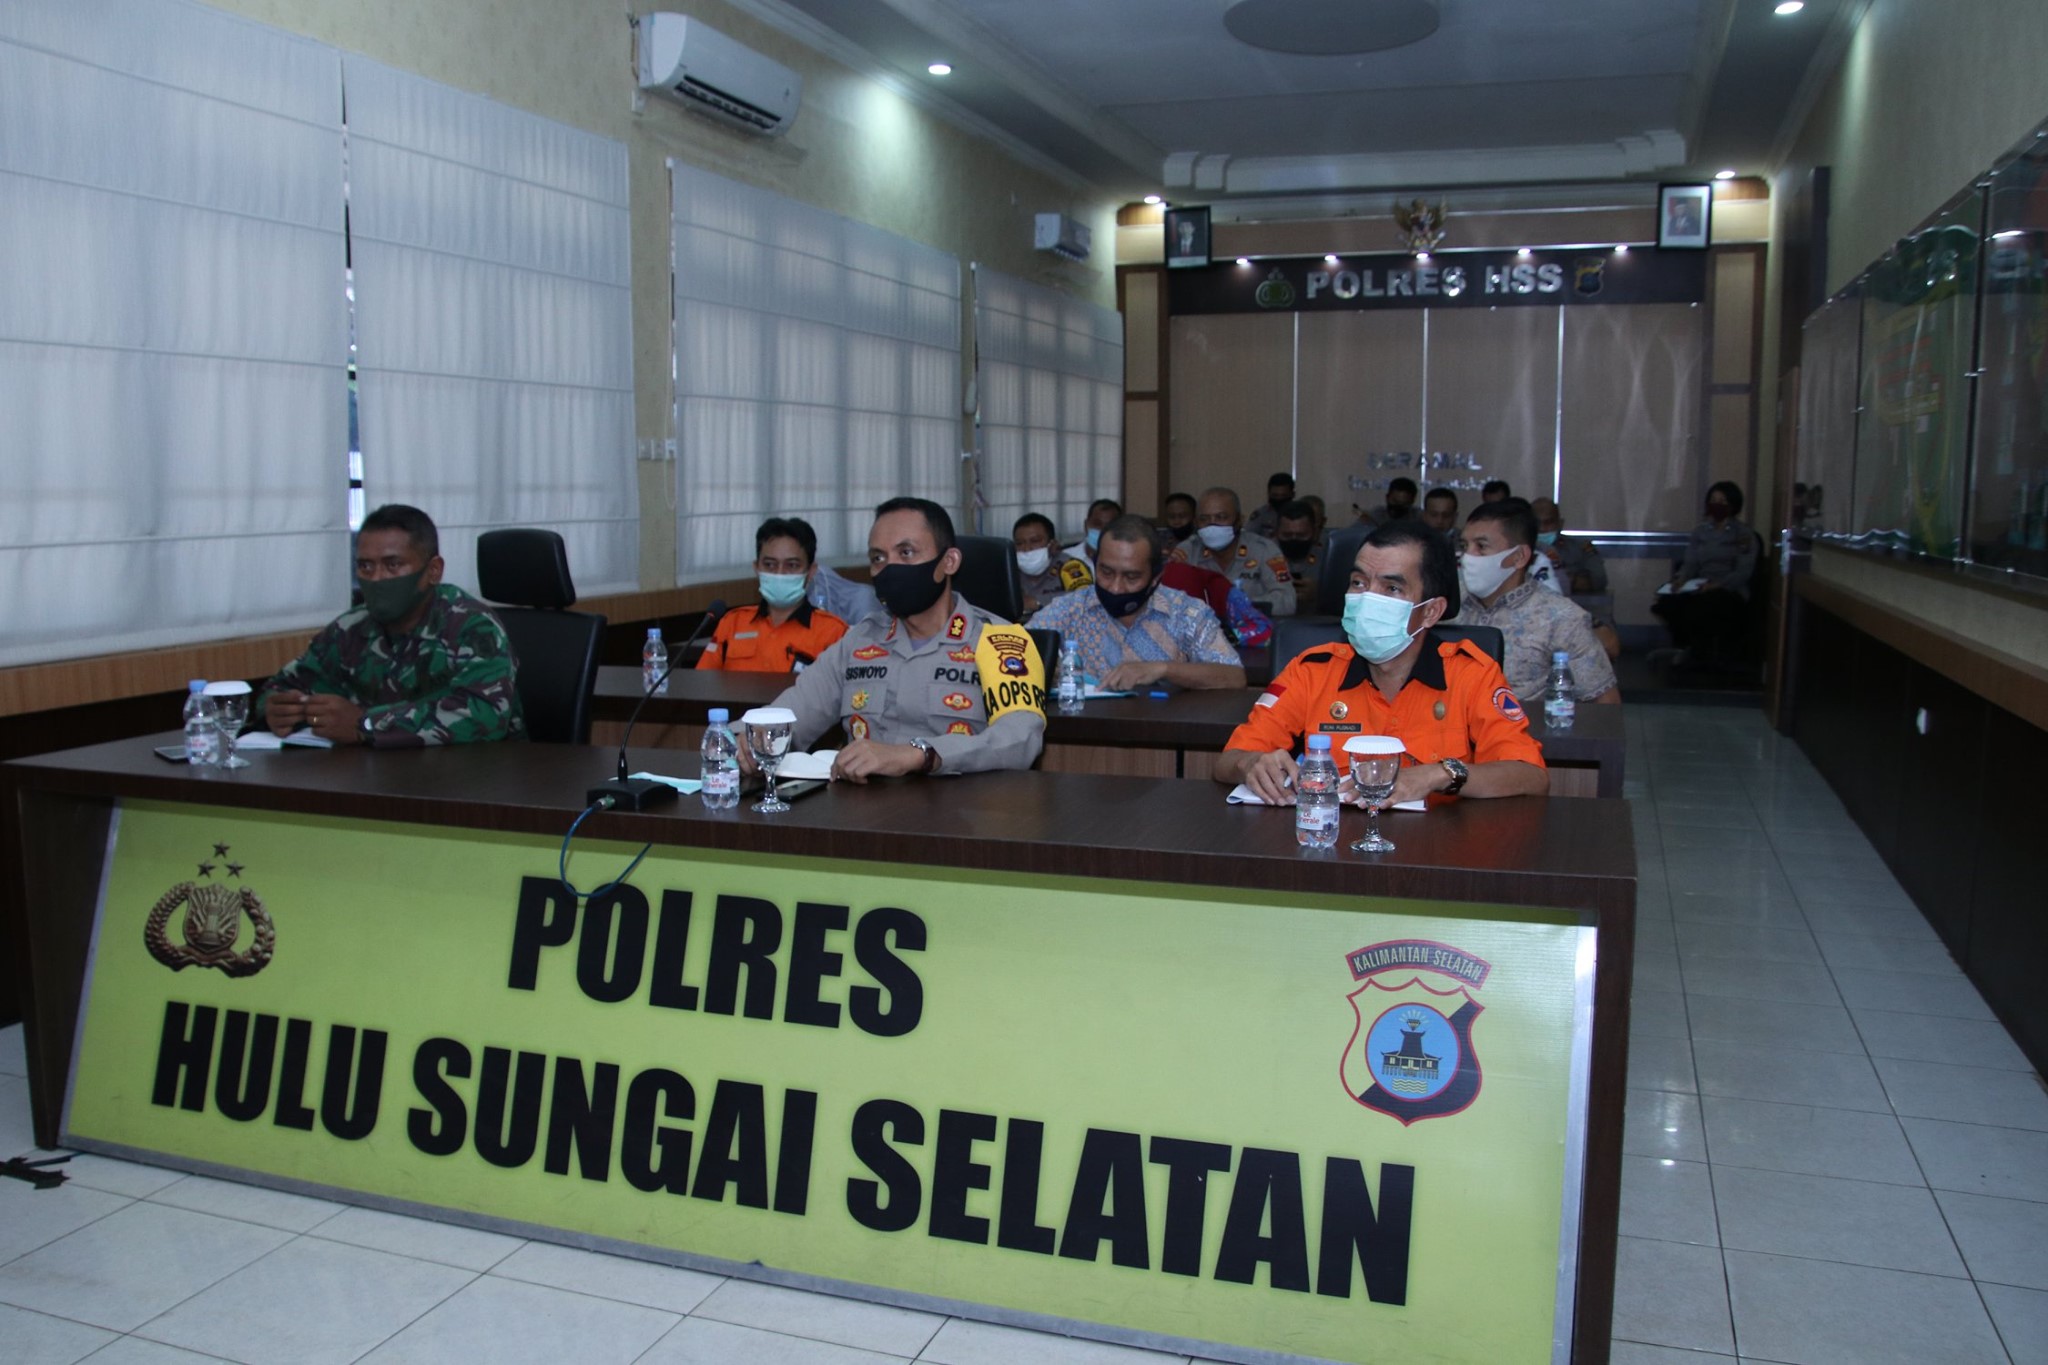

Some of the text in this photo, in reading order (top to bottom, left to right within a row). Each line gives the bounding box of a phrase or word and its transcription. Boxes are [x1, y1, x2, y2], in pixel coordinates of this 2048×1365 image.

[1306, 263, 1564, 299] POLRES HSS
[845, 665, 888, 681] SISWOYO
[999, 680, 1032, 708] OPS
[508, 875, 928, 1037] POLRES
[1353, 946, 1484, 981] KALIMANTAN SELATAN
[151, 1000, 1416, 1307] HULU SUNGAI SELATAN
